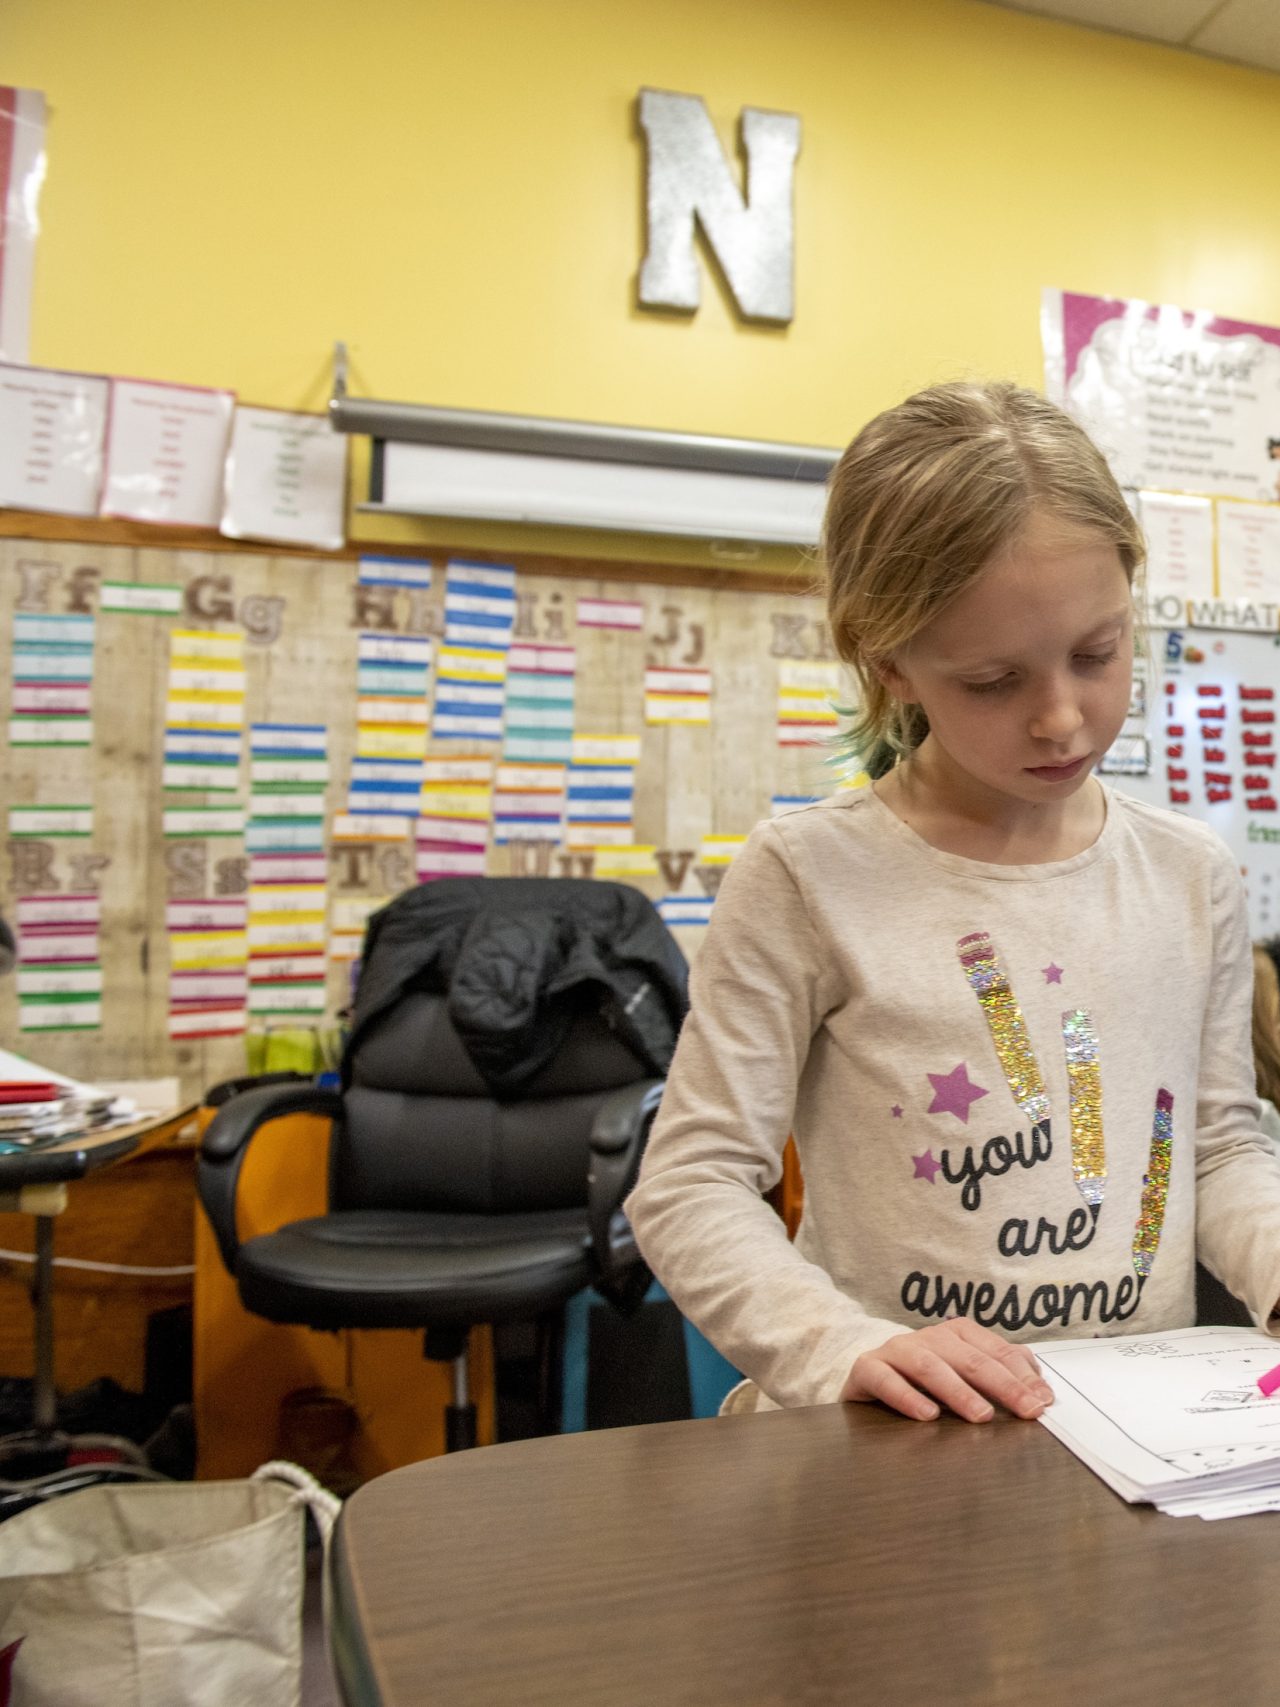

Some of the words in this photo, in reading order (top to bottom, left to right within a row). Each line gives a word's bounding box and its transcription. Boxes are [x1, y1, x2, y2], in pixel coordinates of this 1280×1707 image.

[637, 85, 803, 330] N
[1194, 602, 1278, 628] WHAT
[941, 1123, 1053, 1212] you
[998, 1206, 1097, 1258] are
[901, 1271, 1144, 1332] awesome
